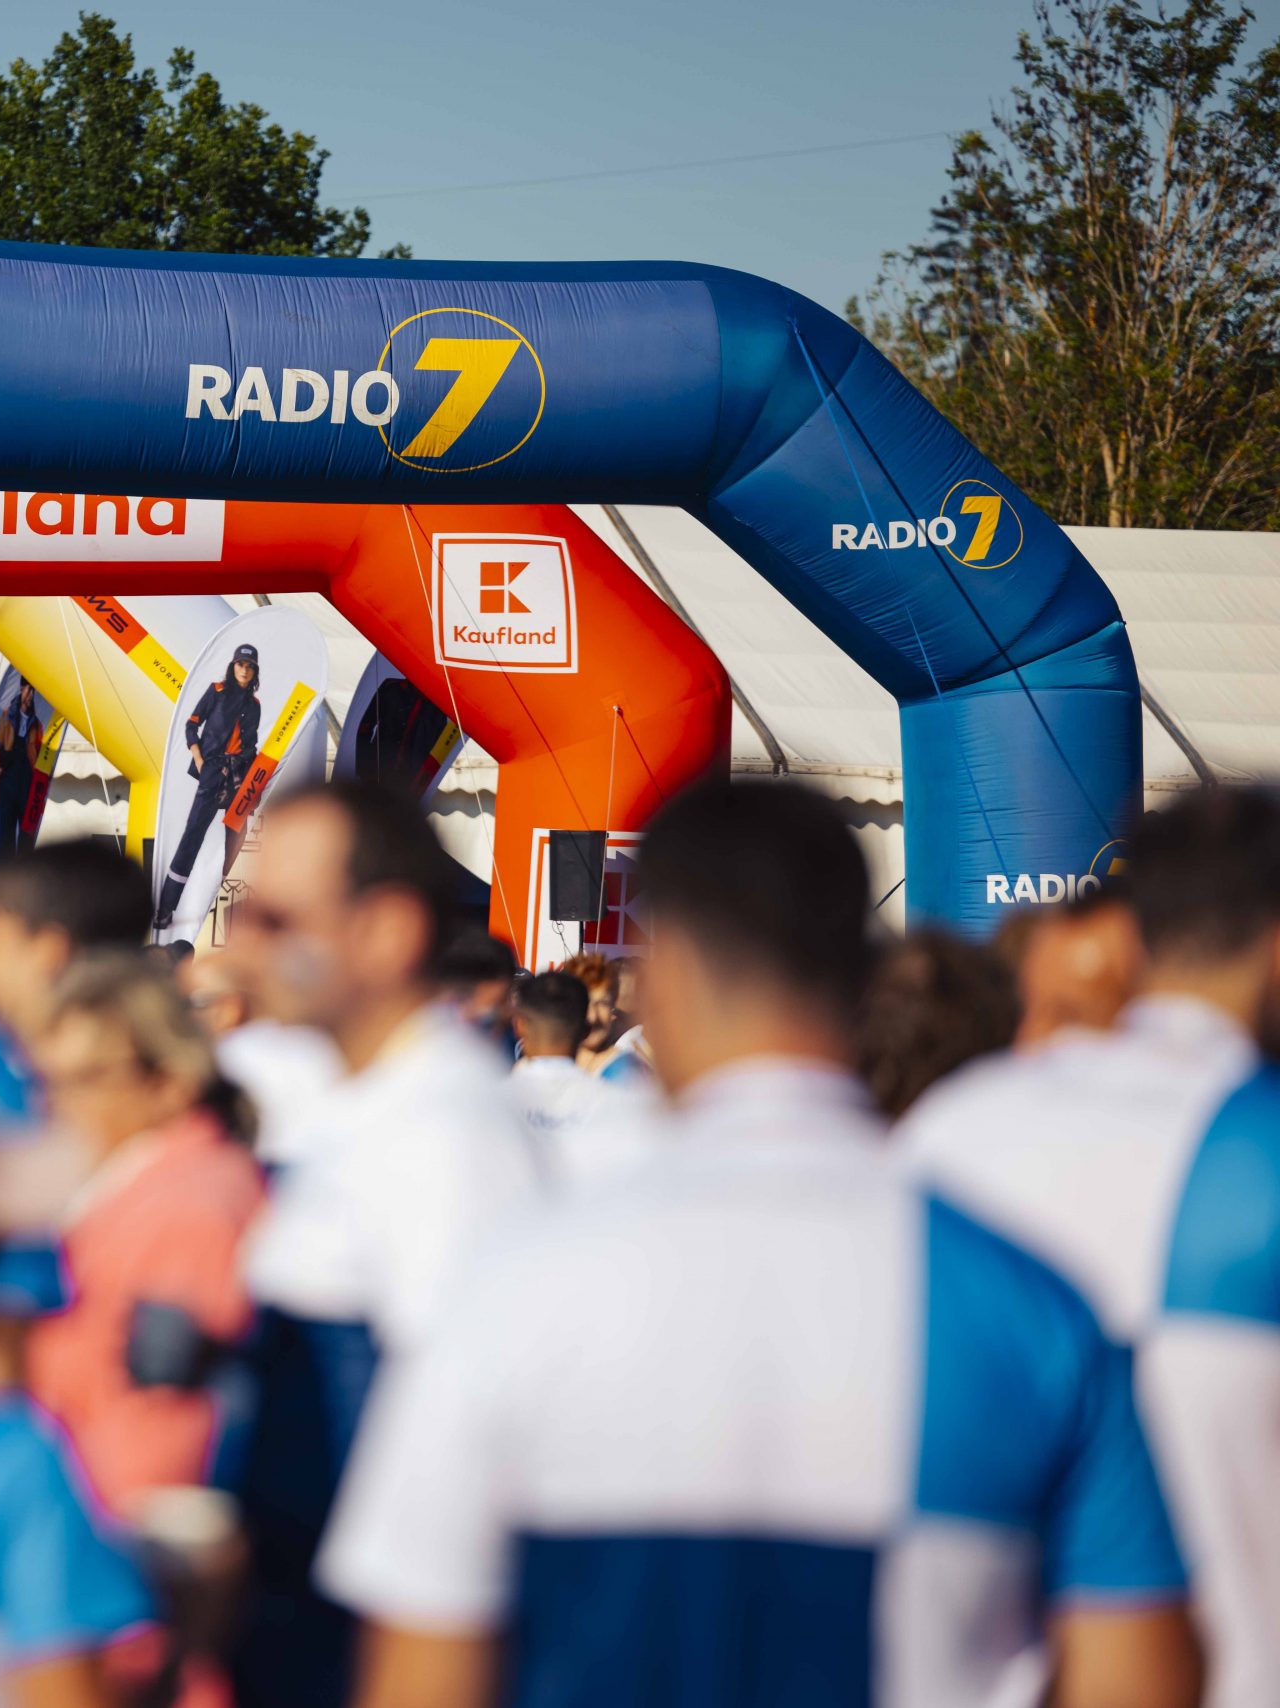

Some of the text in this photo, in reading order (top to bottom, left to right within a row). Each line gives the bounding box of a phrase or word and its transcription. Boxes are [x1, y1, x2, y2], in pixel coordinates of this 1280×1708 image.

[185, 338, 522, 458] RADIO 7
[831, 495, 1002, 562] RADIO 7
[83, 595, 129, 634] WS
[452, 624, 557, 646] Kaufland
[235, 699, 302, 817] CWS WORKWEAR
